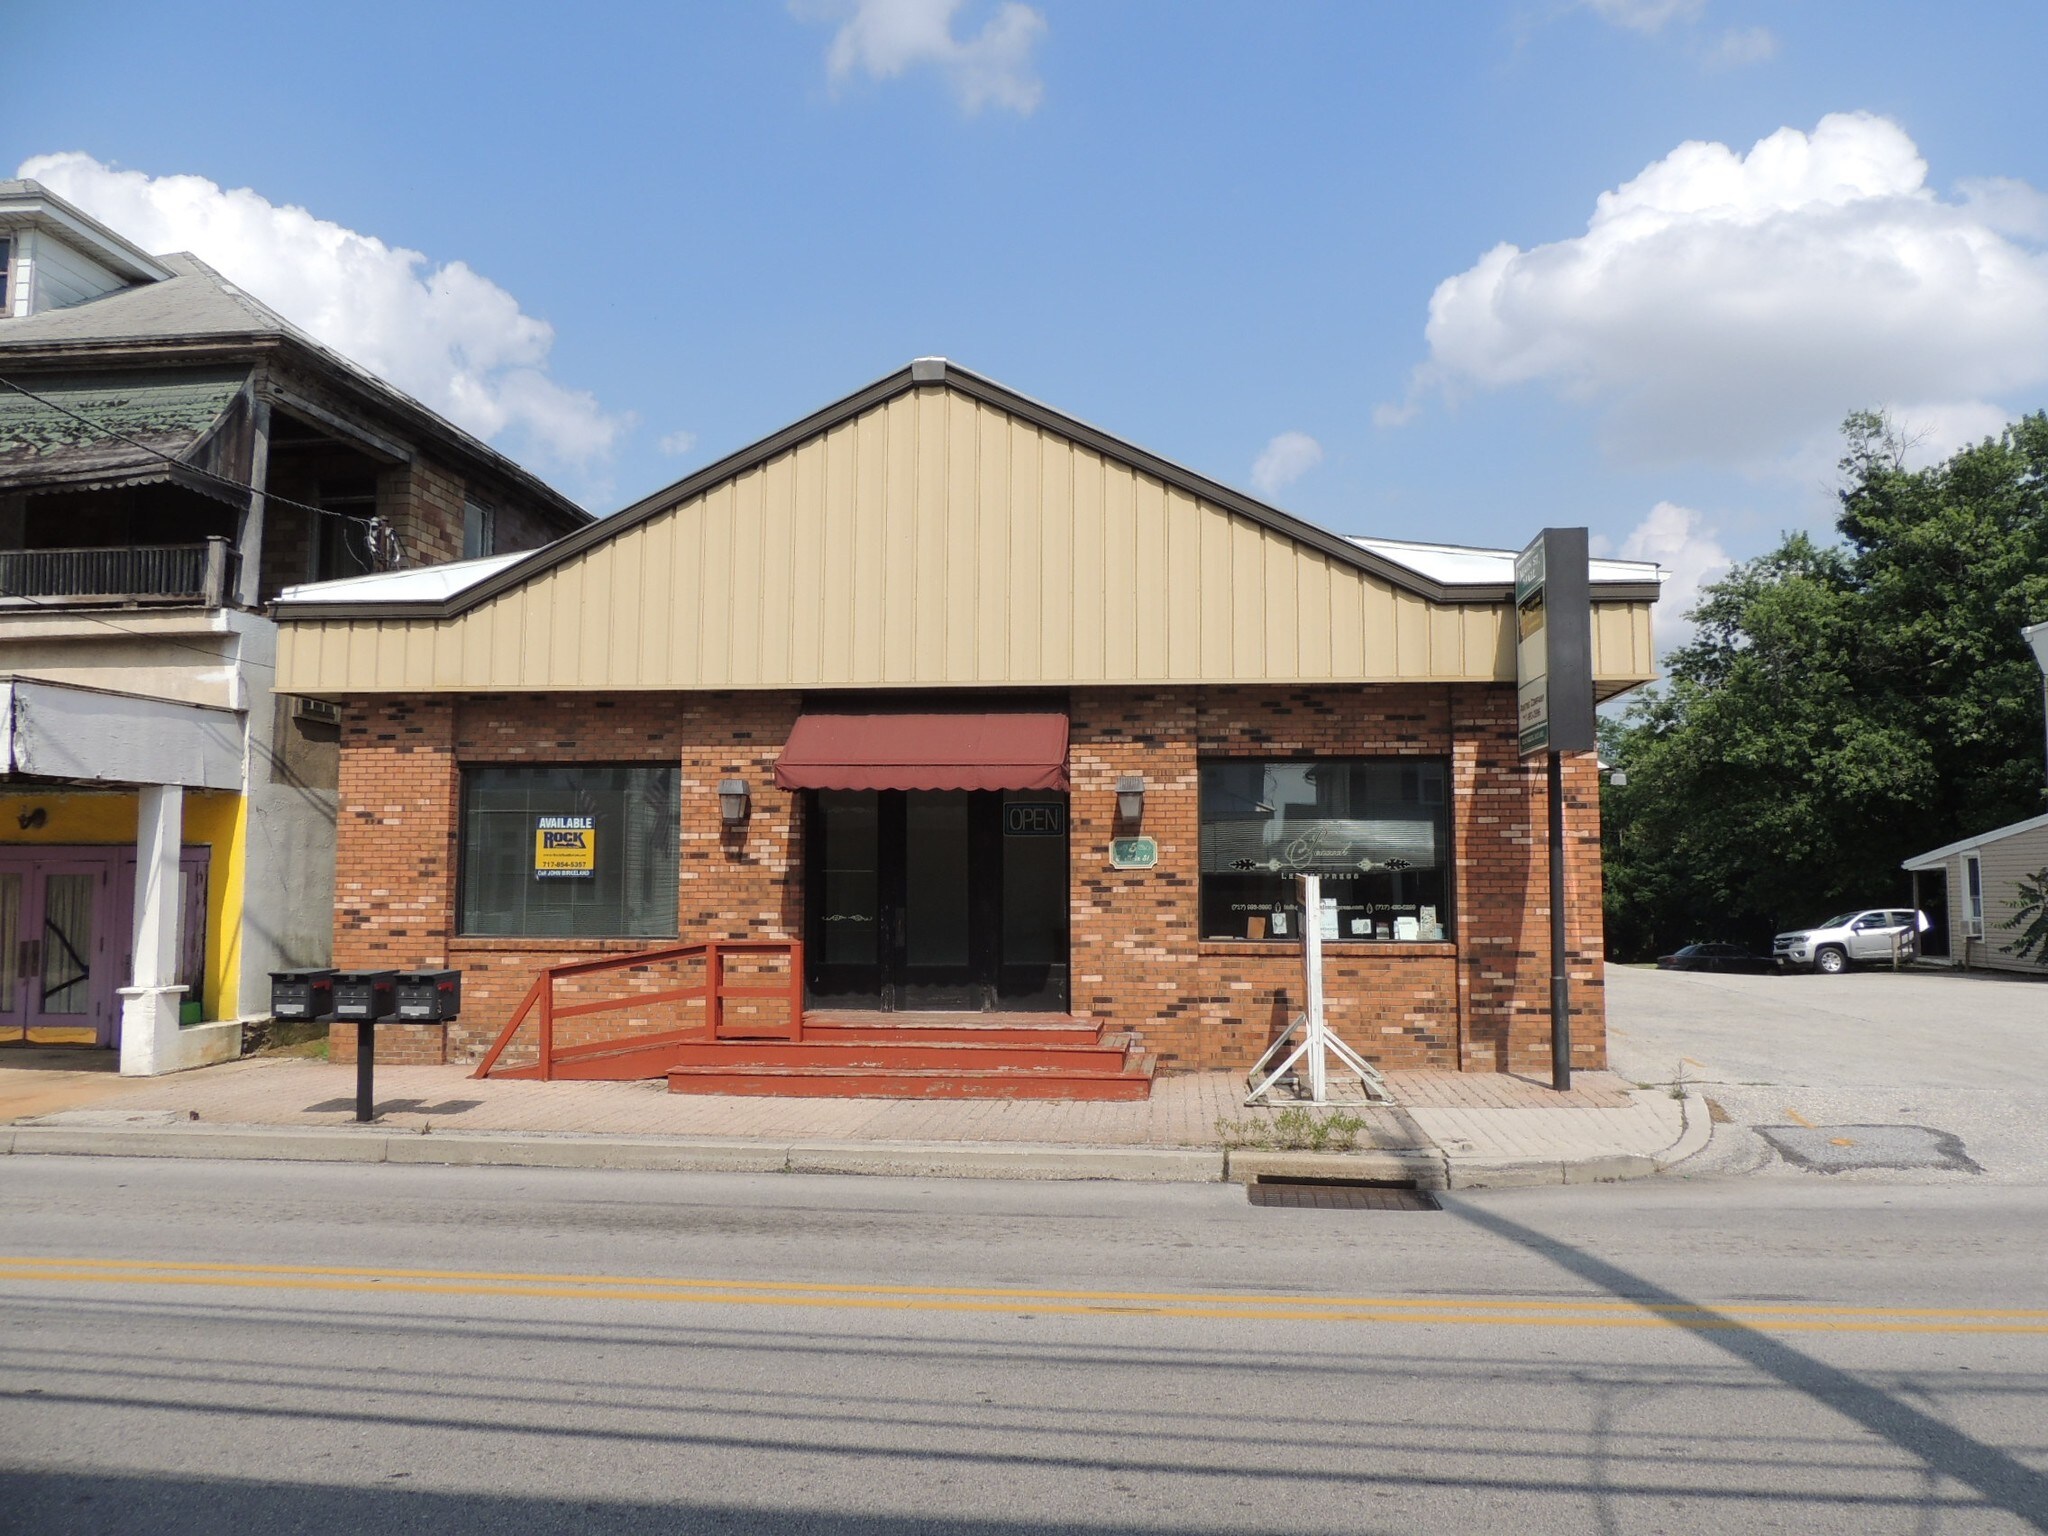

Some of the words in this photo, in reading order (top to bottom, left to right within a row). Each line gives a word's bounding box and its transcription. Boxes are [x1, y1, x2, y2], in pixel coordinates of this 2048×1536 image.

[539, 817, 593, 829] AVAILABLE
[1010, 808, 1058, 830] OPEN
[543, 831, 587, 849] ROCK
